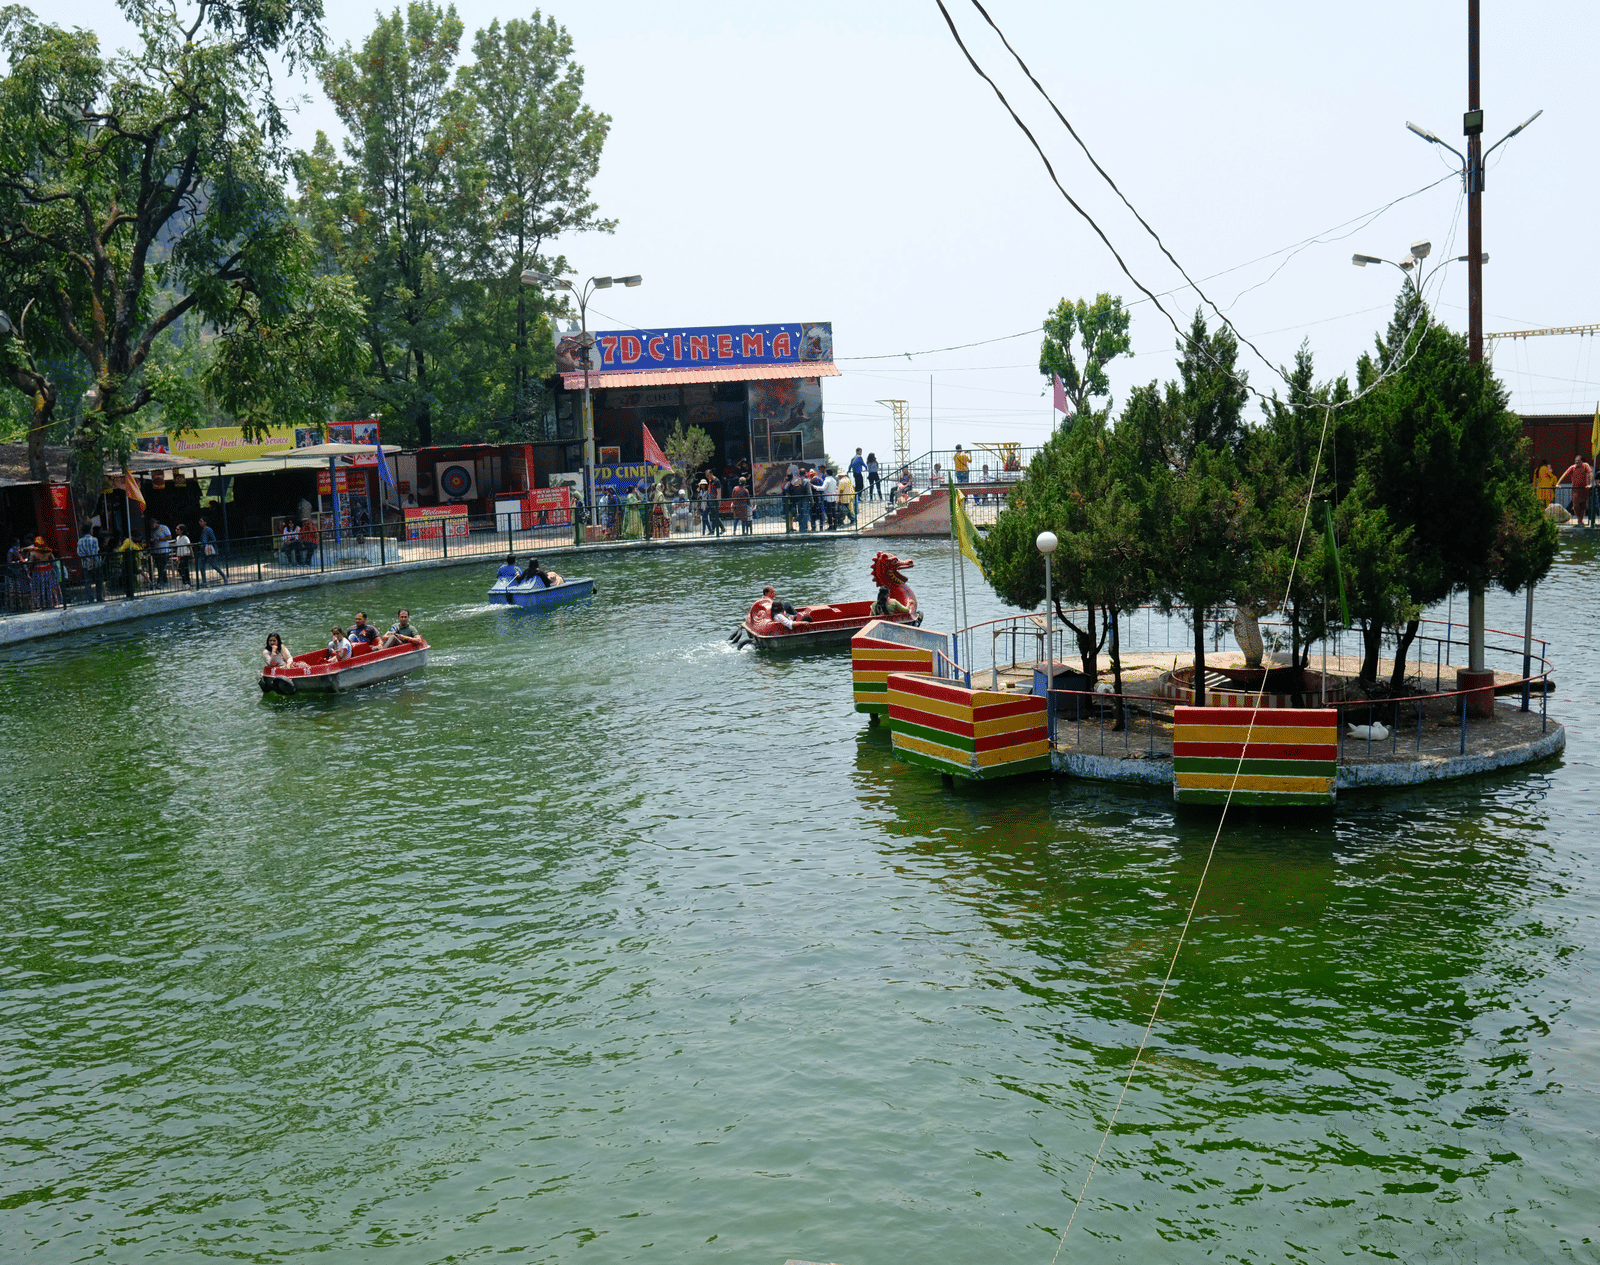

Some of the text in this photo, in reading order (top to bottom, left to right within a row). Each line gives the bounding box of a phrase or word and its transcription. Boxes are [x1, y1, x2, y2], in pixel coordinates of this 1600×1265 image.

[601, 332, 791, 364] 7D CINEMA
[264, 435, 290, 446] Service
